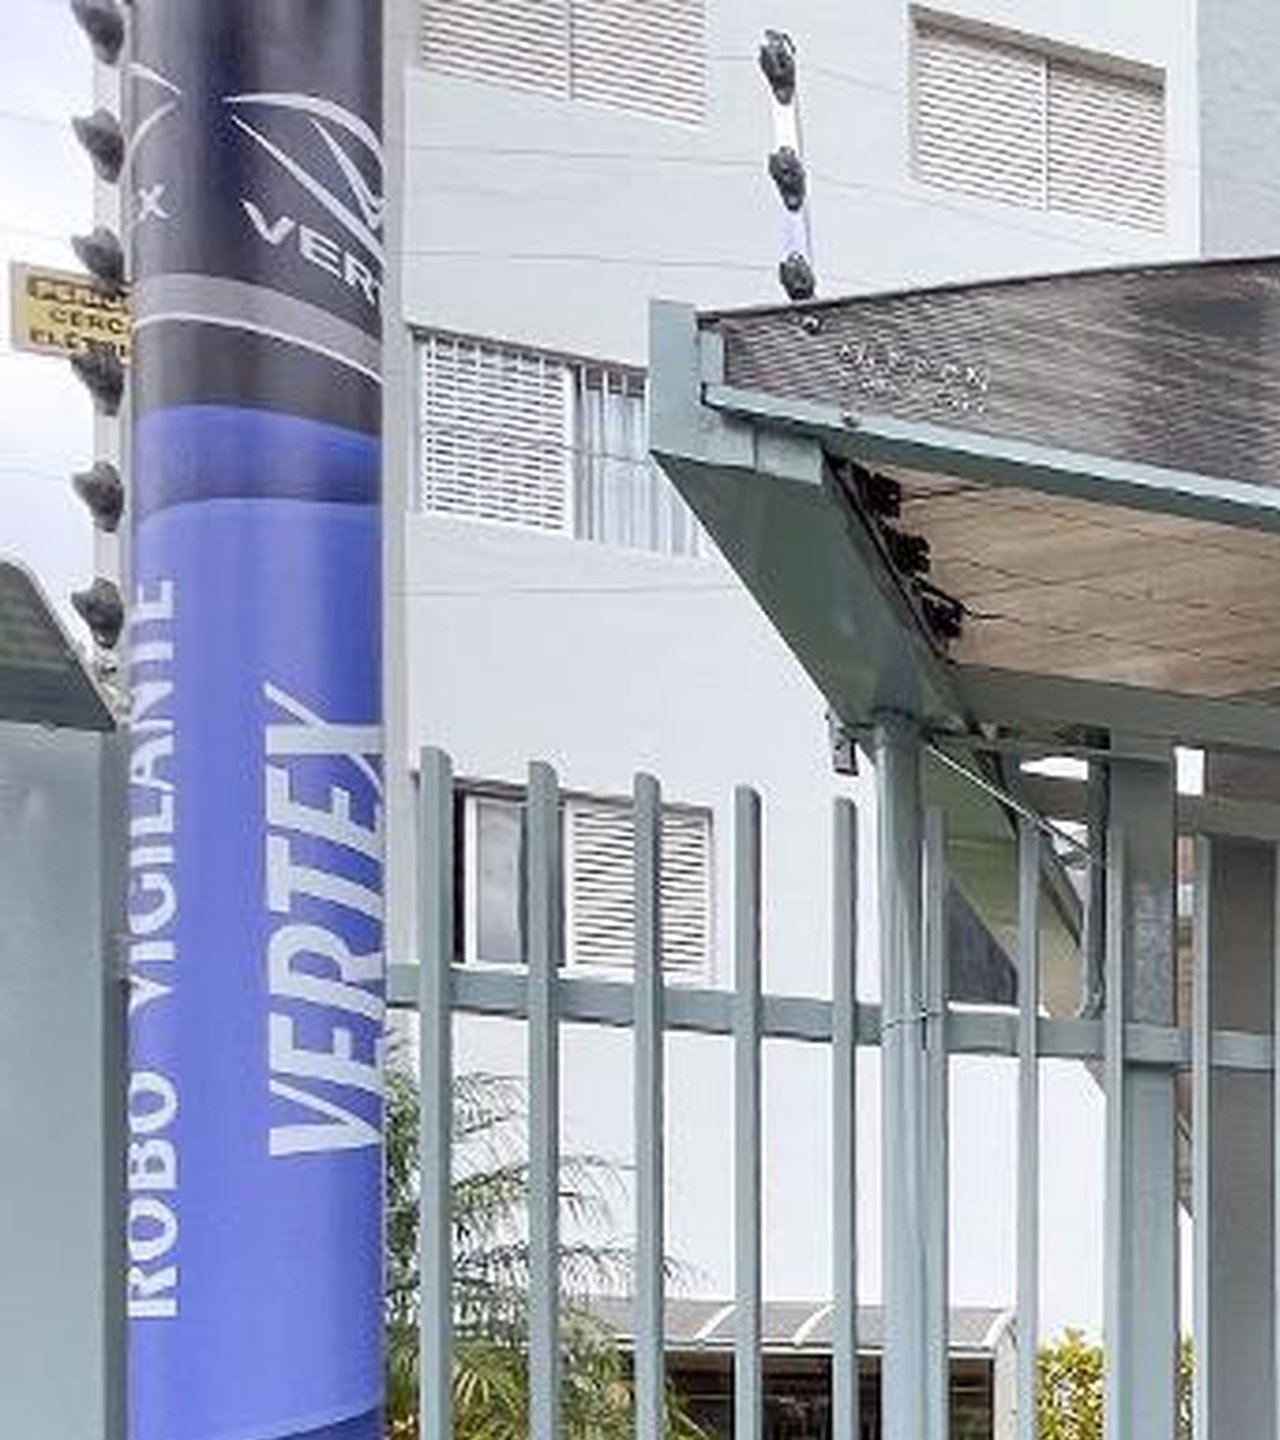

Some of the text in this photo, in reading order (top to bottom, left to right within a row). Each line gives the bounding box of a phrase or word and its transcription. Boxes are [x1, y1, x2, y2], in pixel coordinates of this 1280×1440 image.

[49, 309, 130, 334] CERC
[239, 198, 382, 305] VER
[127, 579, 178, 1320] ROBO VIGILANTE
[264, 680, 385, 1157] VERTEX
